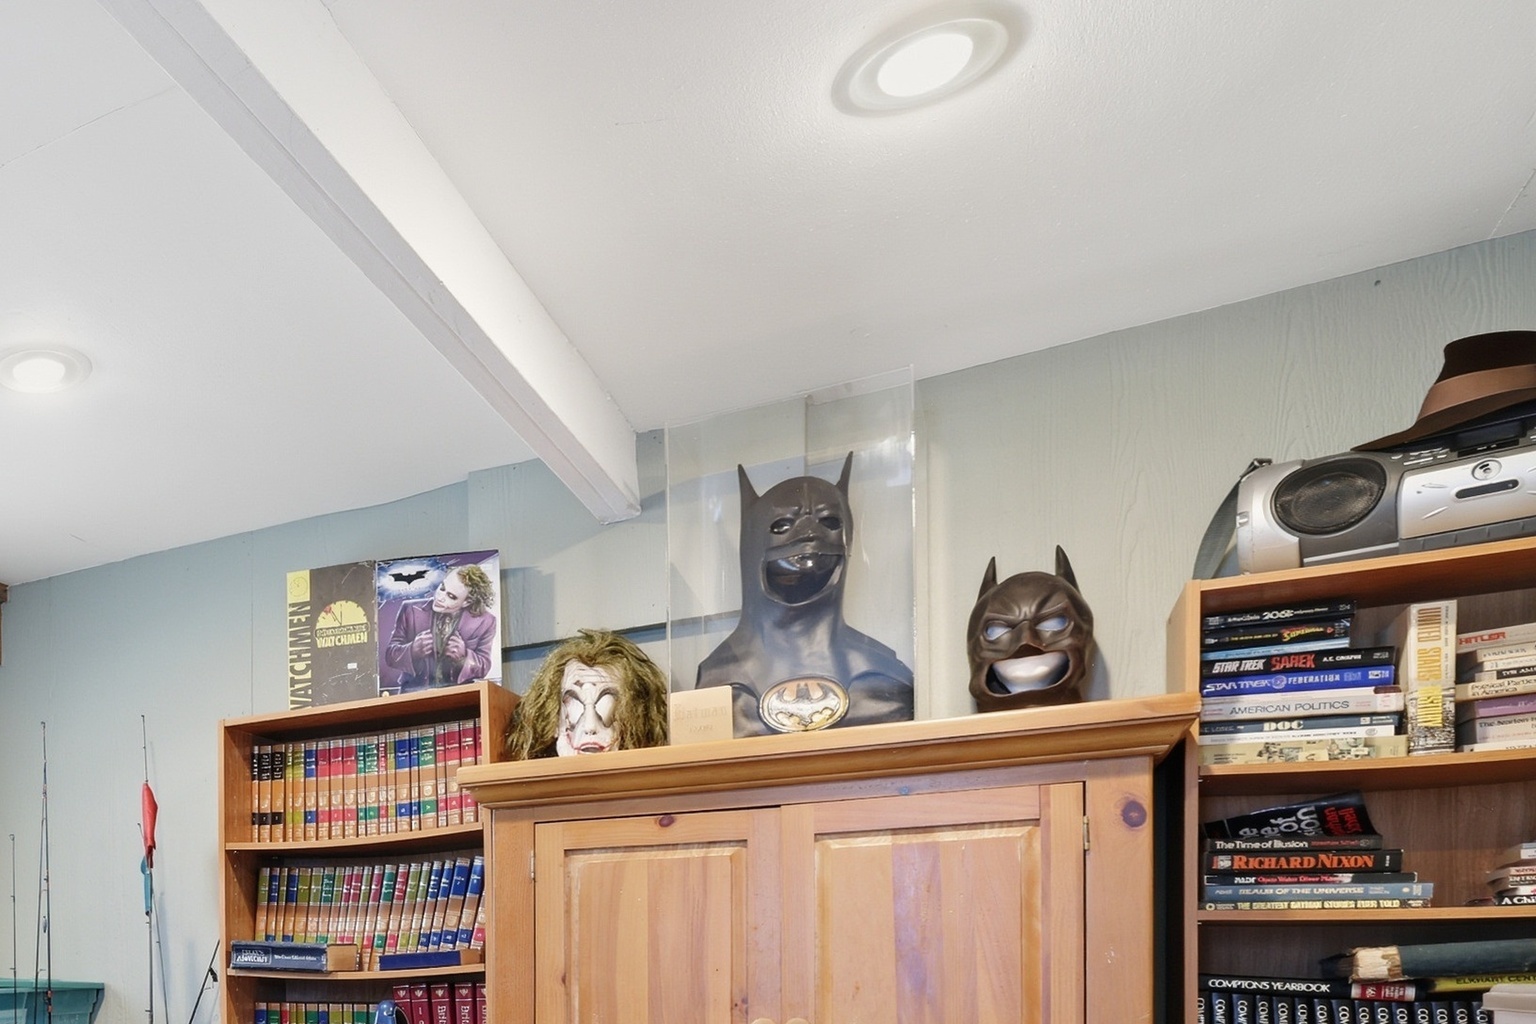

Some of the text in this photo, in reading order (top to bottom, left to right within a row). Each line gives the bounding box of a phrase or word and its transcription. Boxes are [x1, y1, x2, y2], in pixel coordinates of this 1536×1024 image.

[316, 632, 368, 649] WATCHMEN
[1458, 631, 1506, 645] HITLER
[1212, 660, 1240, 674] STAR
[1240, 658, 1266, 672] TREK
[1270, 654, 1317, 671] SAREK
[1203, 682, 1237, 694] STAR
[1239, 680, 1271, 689] TREK
[1229, 704, 1291, 716] AMERICAN
[1294, 700, 1350, 712] POLITICS
[1263, 720, 1304, 731] DOC
[1215, 840, 1234, 849] The
[1235, 840, 1260, 849] Time
[1232, 853, 1374, 870] RICHARD NIXON
[1502, 896, 1512, 905] A
[1271, 980, 1331, 993] YEARBOOK
